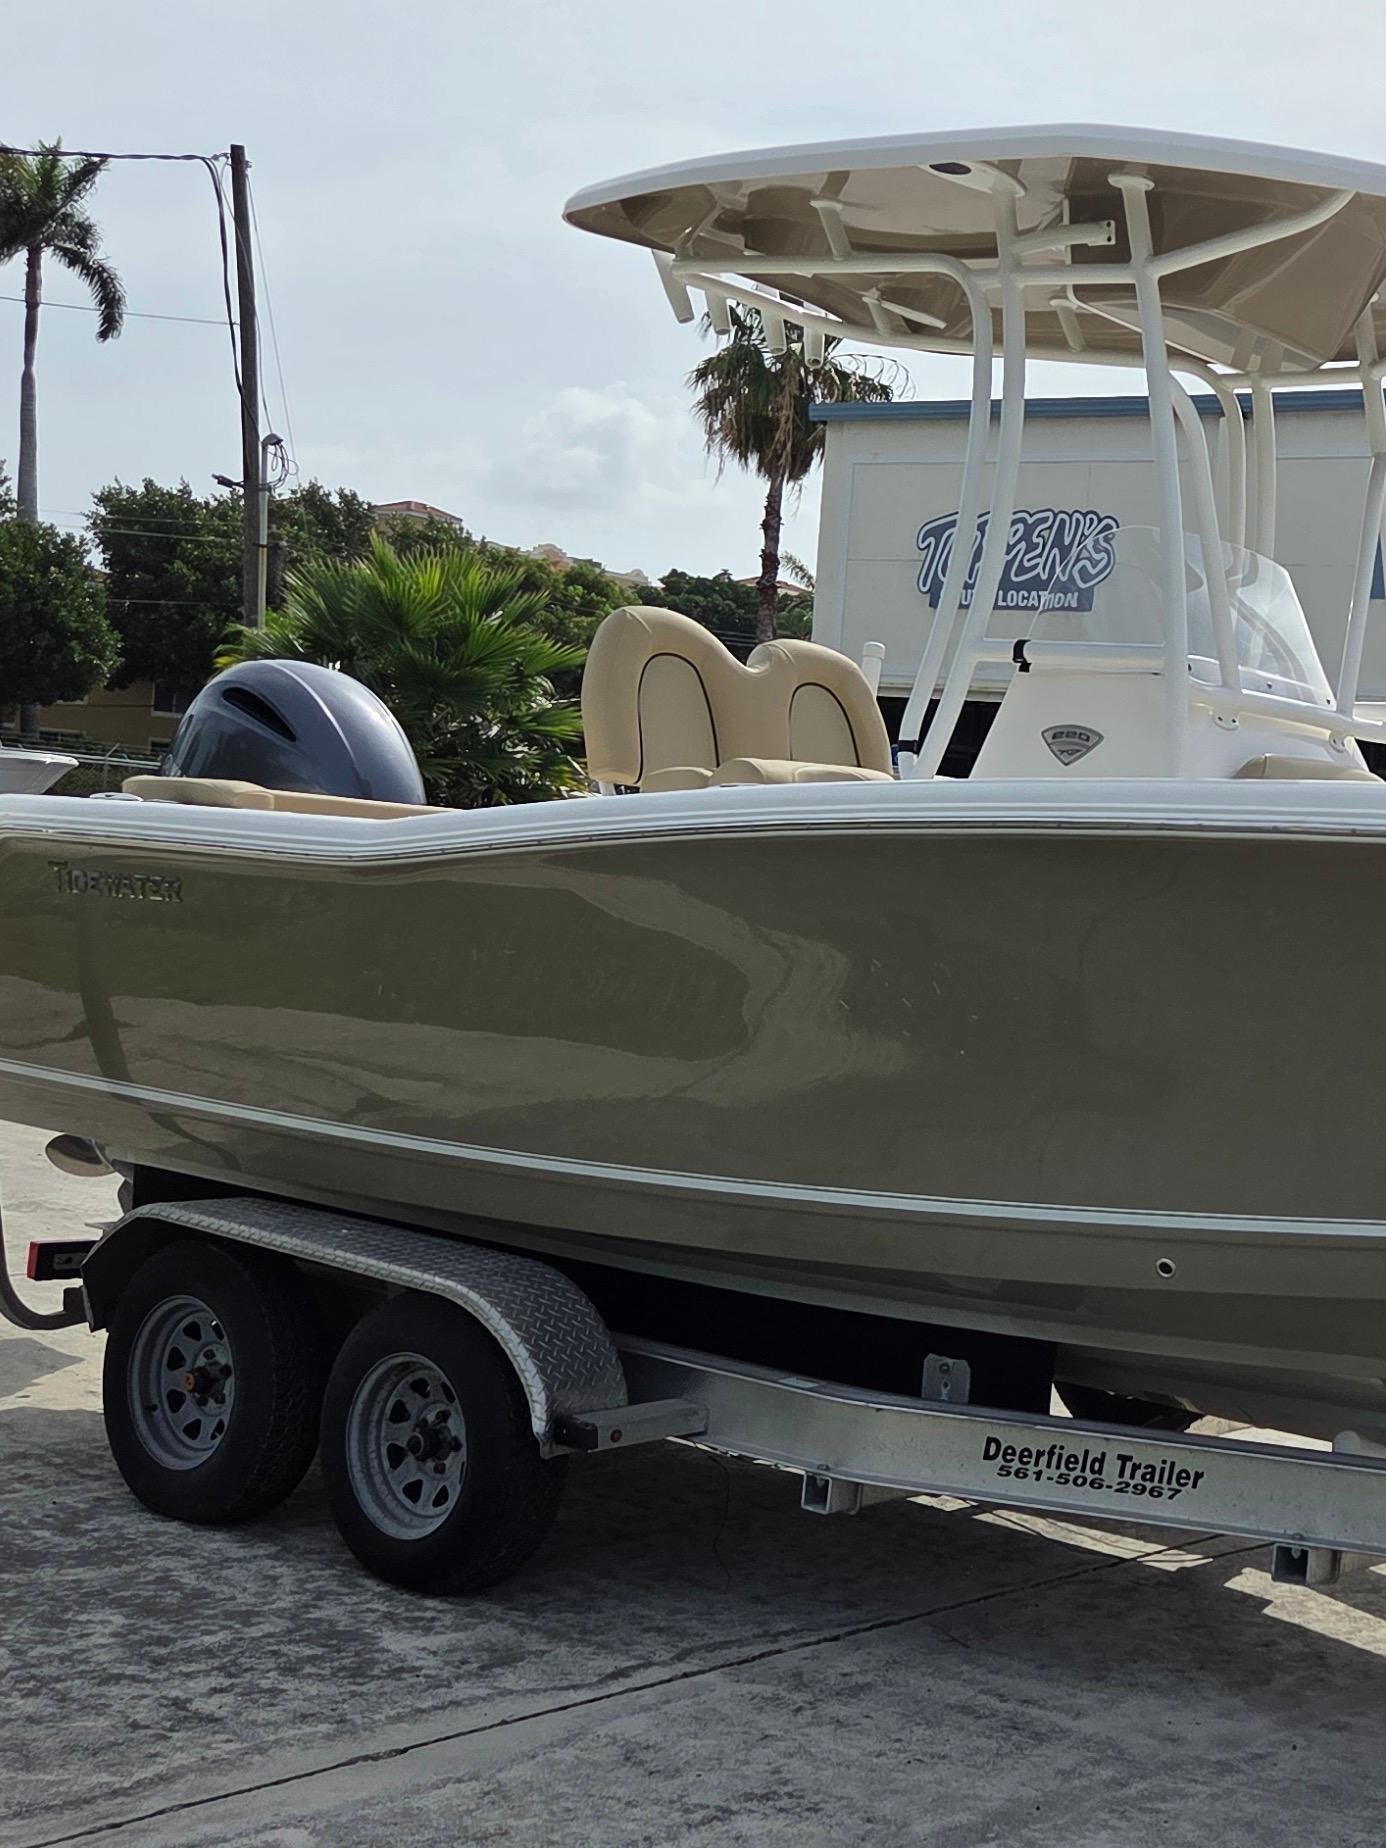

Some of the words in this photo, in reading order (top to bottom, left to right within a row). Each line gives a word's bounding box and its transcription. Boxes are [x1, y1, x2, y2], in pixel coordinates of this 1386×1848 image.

[917, 510, 1120, 593] TPEN'S
[997, 590, 1078, 608] LOCATION
[48, 860, 183, 902] TIDEWATER
[983, 1436, 1106, 1476] Deerfield
[1116, 1454, 1204, 1489] Trailer
[997, 1465, 1183, 1500] 561-506-2967
